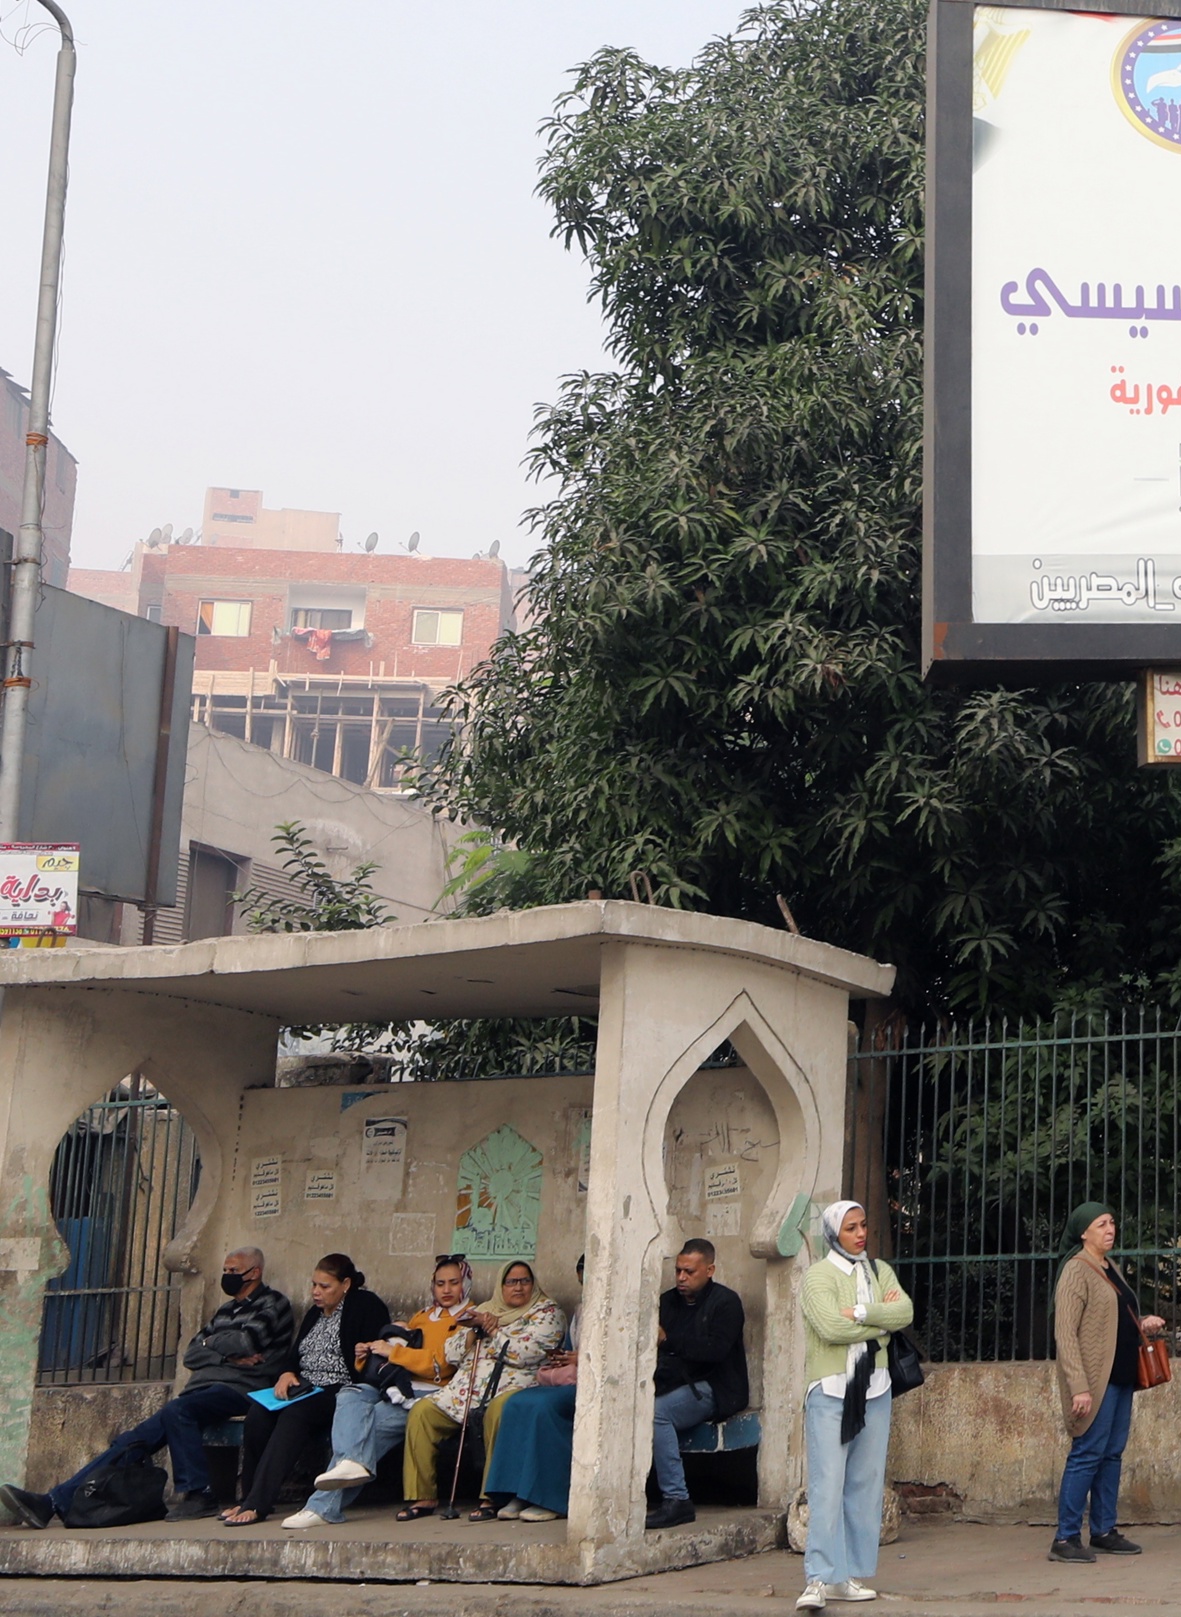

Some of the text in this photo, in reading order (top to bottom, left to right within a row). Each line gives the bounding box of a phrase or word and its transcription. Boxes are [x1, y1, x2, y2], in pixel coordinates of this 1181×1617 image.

[42, 857, 74, 871] جيم
[1, 874, 63, 907] بداية
[11, 911, 39, 922] نحافة
